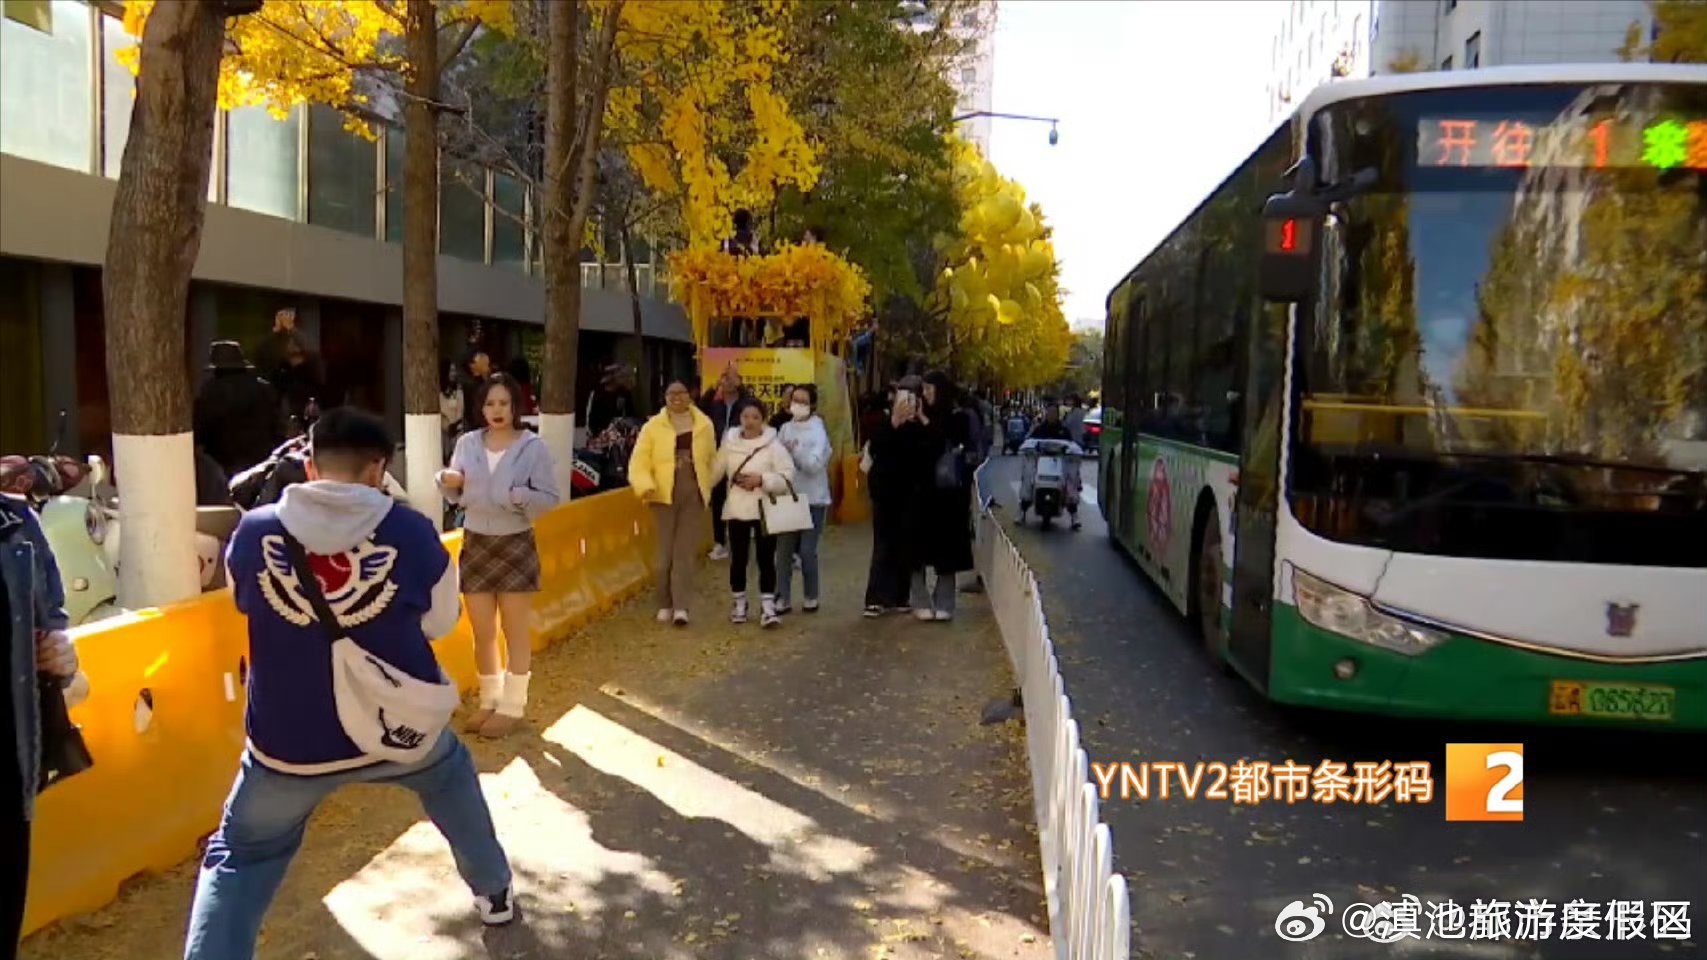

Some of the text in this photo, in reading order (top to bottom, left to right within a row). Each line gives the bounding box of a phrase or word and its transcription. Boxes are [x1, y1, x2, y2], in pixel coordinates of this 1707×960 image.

[1436, 117, 1611, 170] 开往 1
[1281, 217, 1295, 250] 1
[391, 724, 427, 748] NIKE
